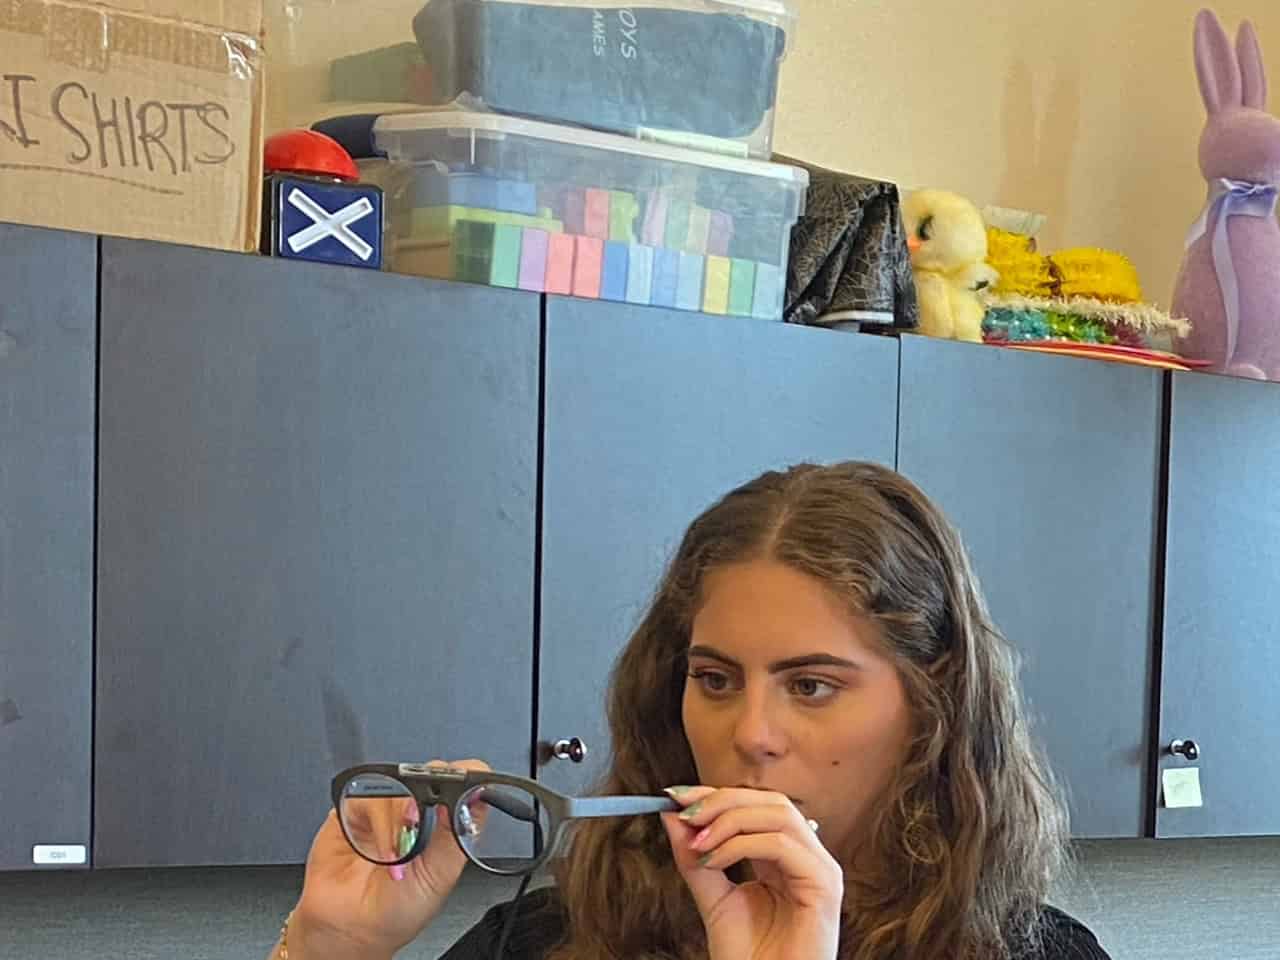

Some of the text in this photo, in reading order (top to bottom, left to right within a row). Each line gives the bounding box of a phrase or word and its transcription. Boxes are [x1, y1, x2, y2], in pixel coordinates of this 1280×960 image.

[592, 8, 606, 56] AMES
[619, 7, 637, 60] OYS
[51, 81, 236, 175] SHIRTS
